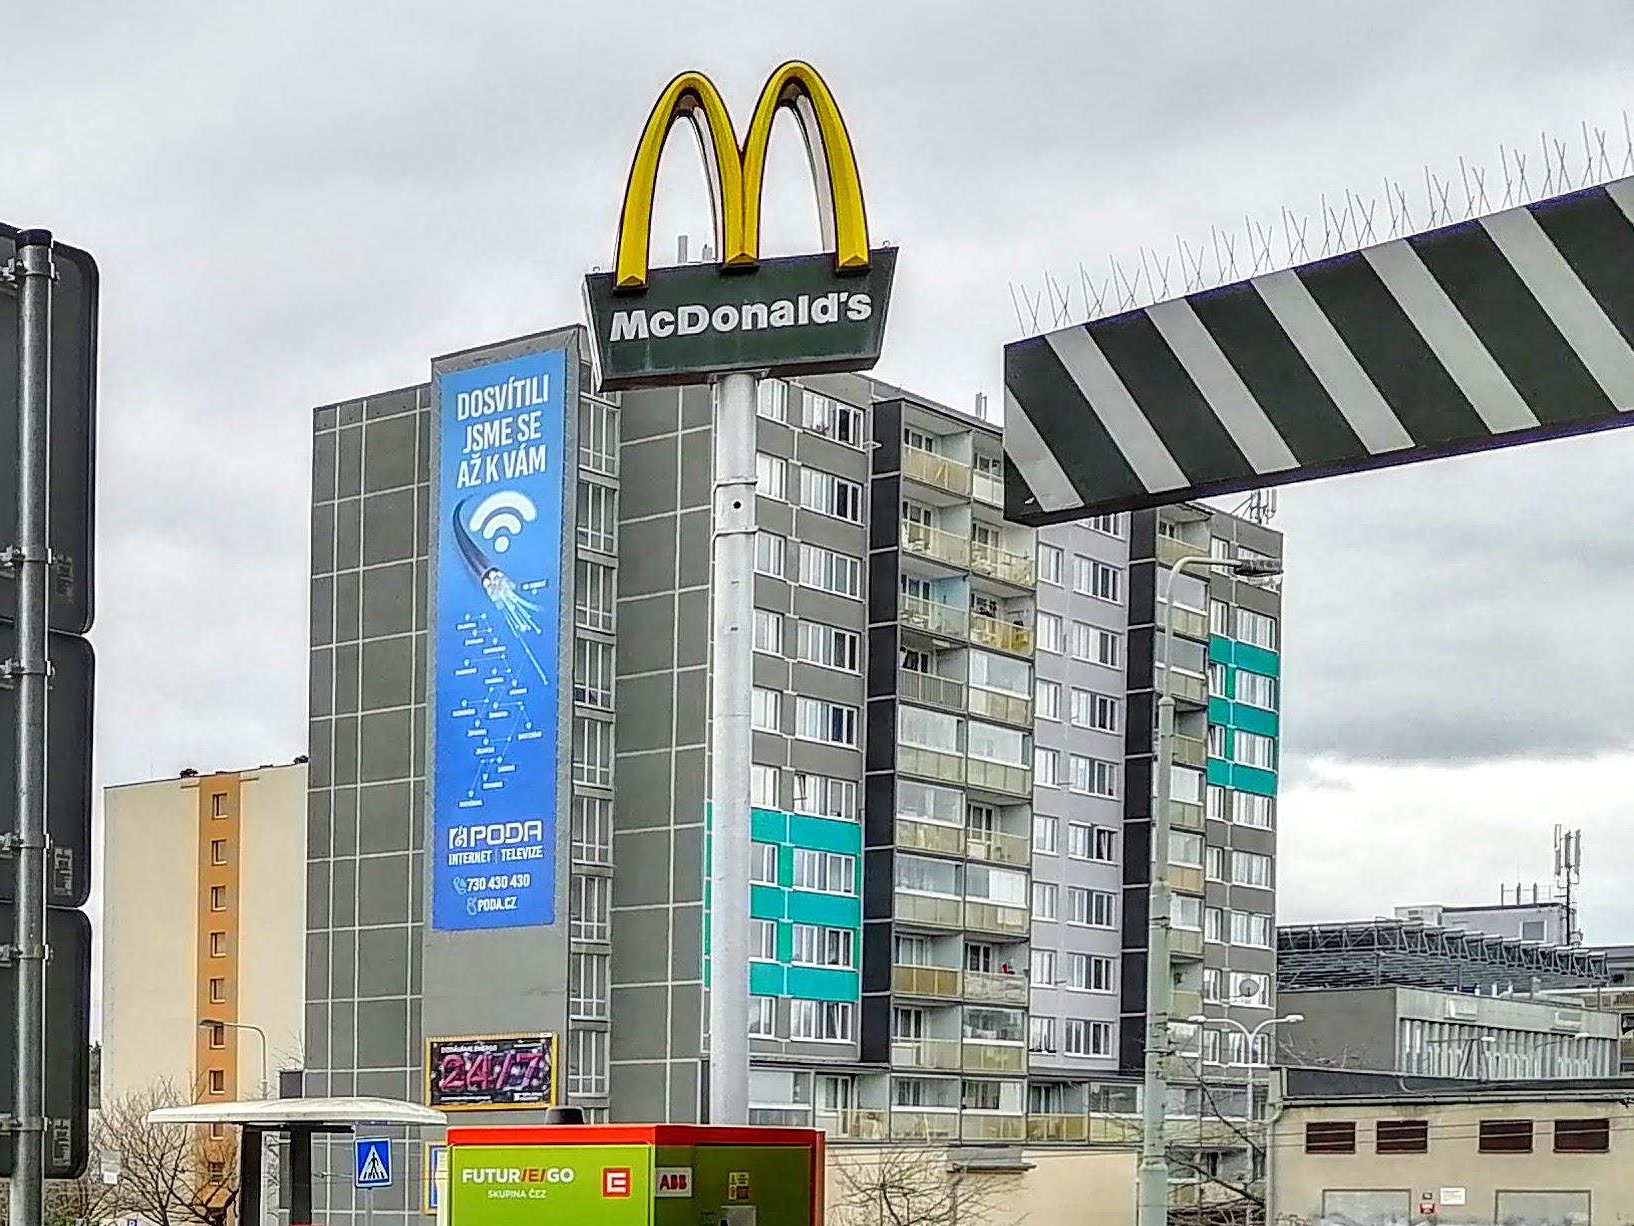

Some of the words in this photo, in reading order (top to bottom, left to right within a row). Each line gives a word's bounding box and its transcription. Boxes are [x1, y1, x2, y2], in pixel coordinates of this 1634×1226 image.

[609, 291, 872, 342] McDonald's
[457, 373, 551, 421] DOSVÍTILI
[462, 416, 513, 454] JSME
[517, 410, 542, 442] SE
[456, 452, 482, 488] AŽ
[485, 454, 499, 484] K
[502, 442, 547, 480] VÁM
[469, 820, 542, 848] PODA
[448, 850, 492, 866] INTERNET
[501, 845, 544, 862] TELEVIZE
[466, 877, 486, 892] 730
[488, 875, 508, 889] 430
[509, 873, 531, 888] 430
[477, 896, 518, 912] PODA.CZ
[440, 1052, 543, 1090] 24/7
[488, 1189, 526, 1199] SKUPINA
[528, 1187, 547, 1199] ČEZ
[659, 1174, 687, 1191] ABB
